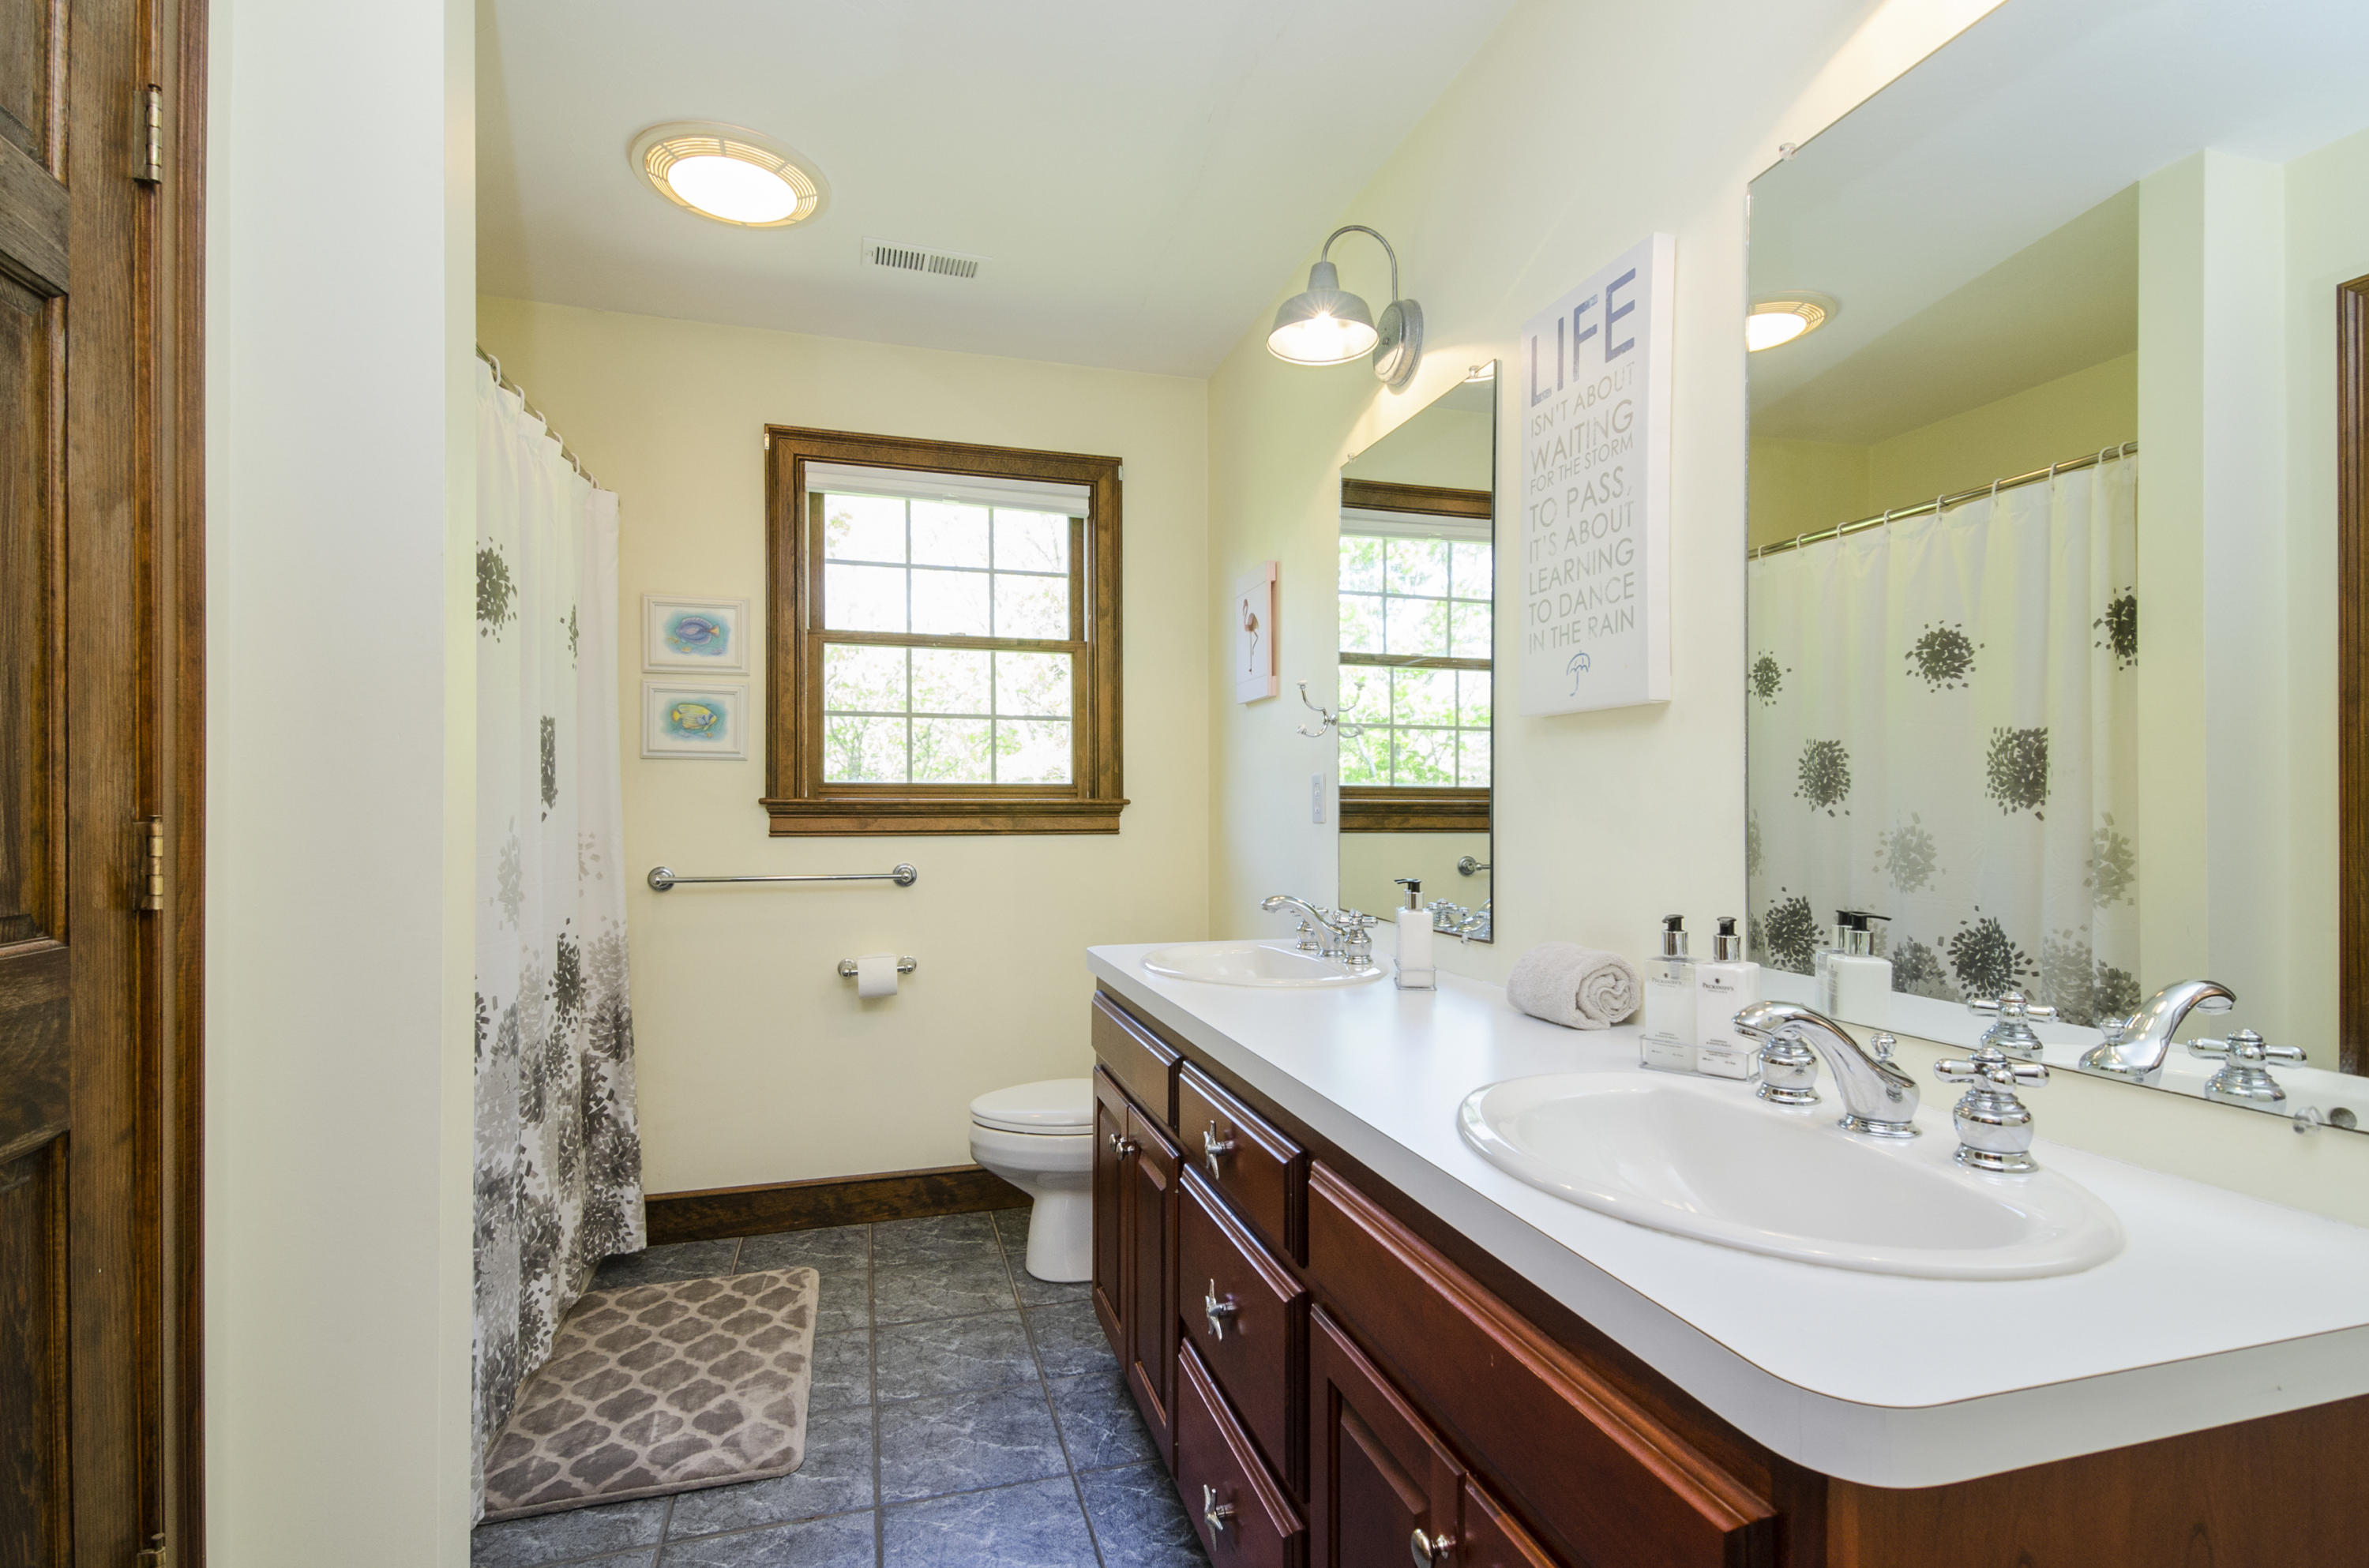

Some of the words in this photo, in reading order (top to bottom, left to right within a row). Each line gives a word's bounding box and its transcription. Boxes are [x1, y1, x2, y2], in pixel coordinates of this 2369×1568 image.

[1531, 268, 1636, 407] LIFE
[1530, 399, 1567, 438] ISN'T
[1573, 362, 1635, 416] ABOUT
[1530, 399, 1634, 475] WAITING
[1530, 470, 1554, 496] FOR
[1559, 457, 1580, 482] THE
[1584, 431, 1634, 470] STORM
[1529, 497, 1558, 533] TO
[1567, 466, 1632, 518] PASS,
[1529, 531, 1557, 564] IT'S
[1564, 500, 1634, 551] ABOUT
[1528, 598, 1552, 626] TO
[1560, 571, 1635, 618] DANCE
[1529, 537, 1635, 596] LEARNING
[1528, 629, 1545, 655] IN
[1550, 619, 1581, 649] THE
[1587, 605, 1634, 640] RAIN
